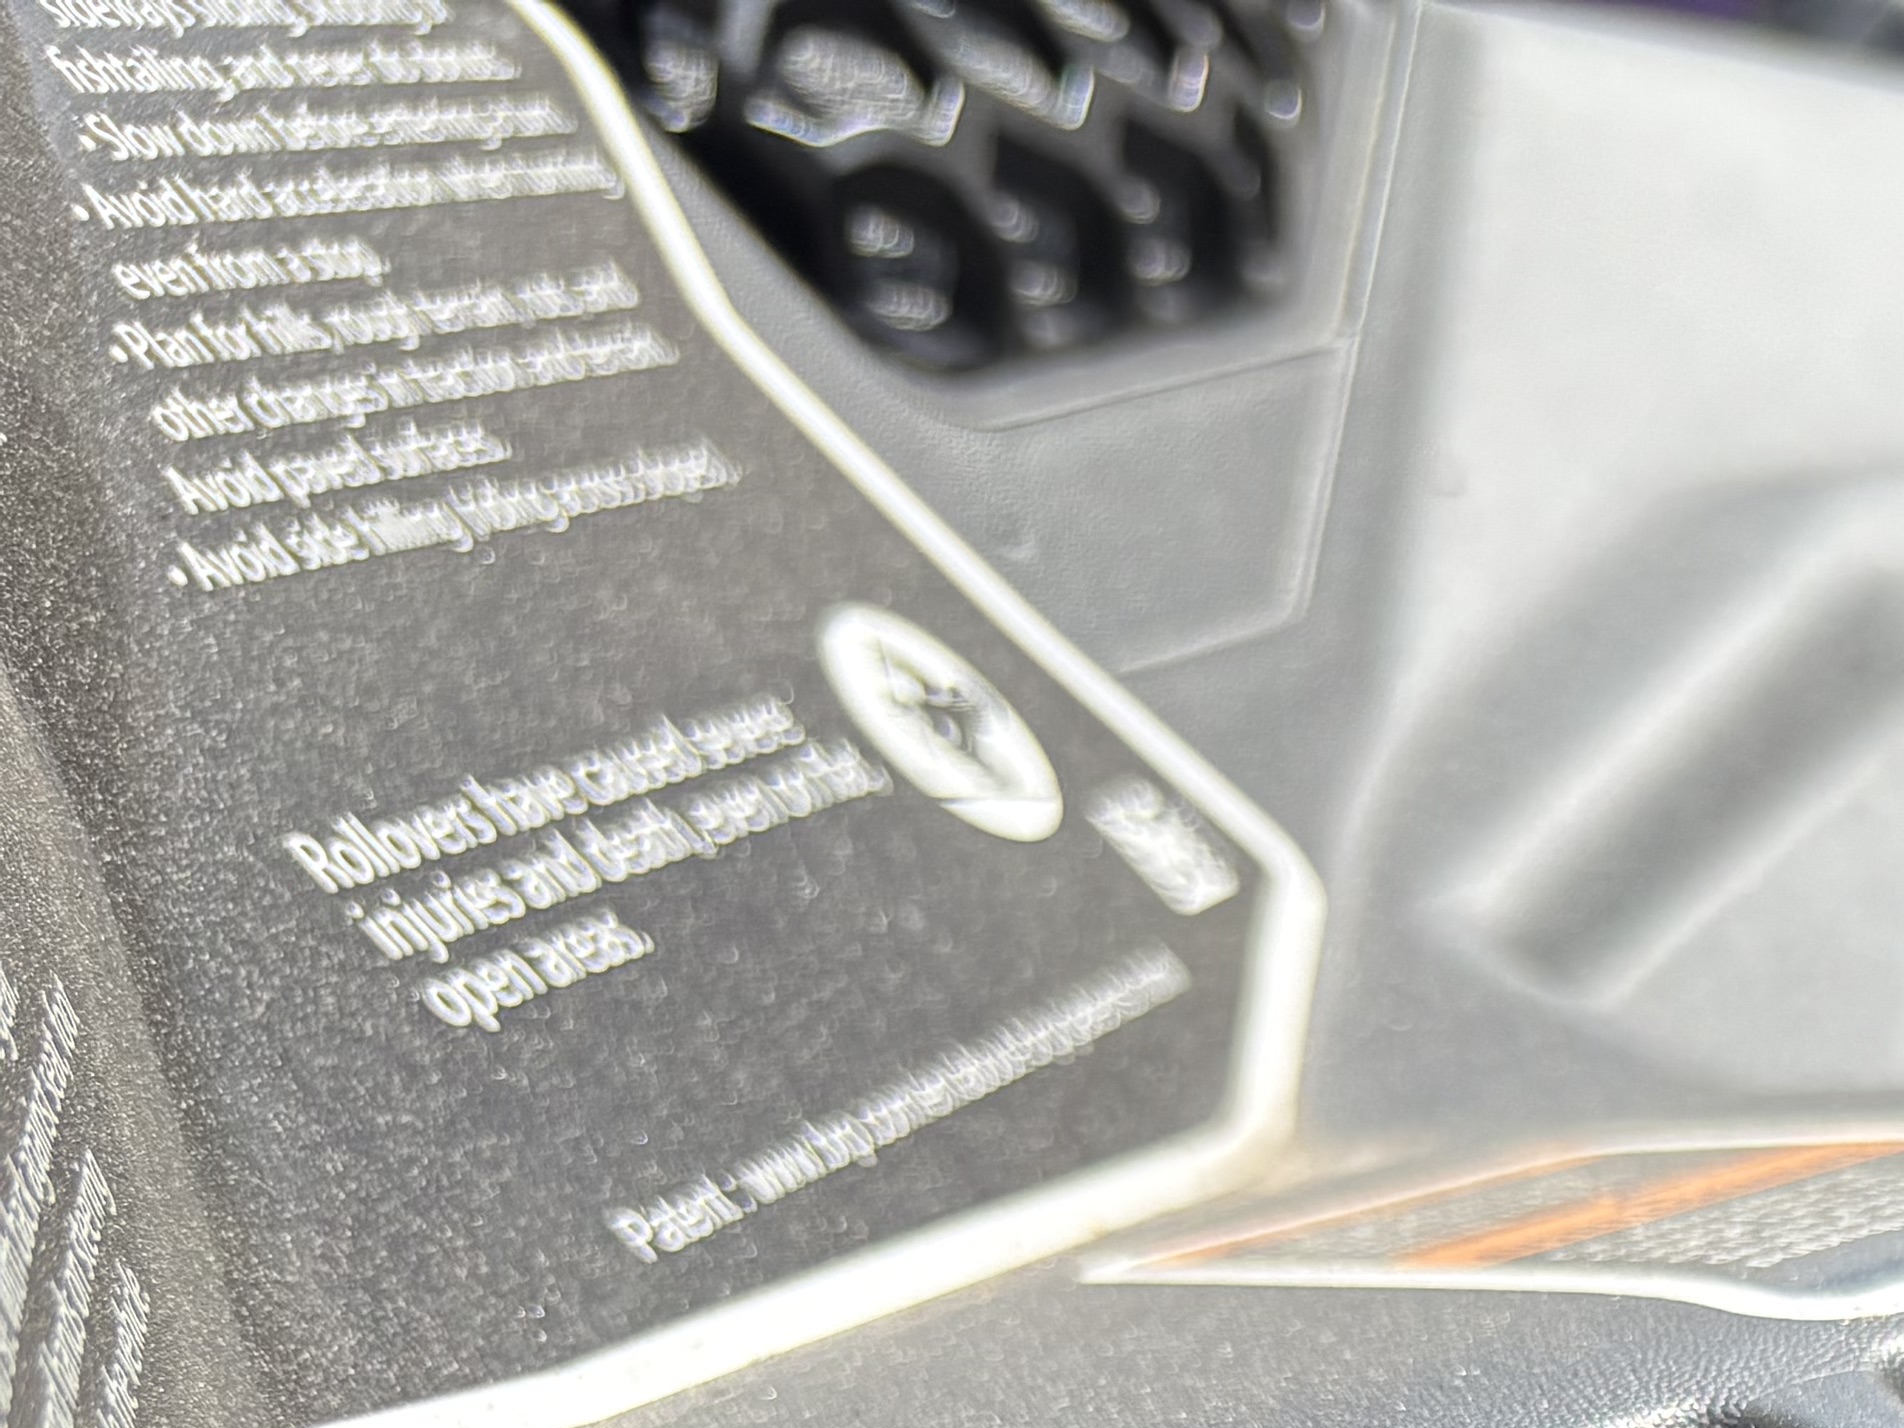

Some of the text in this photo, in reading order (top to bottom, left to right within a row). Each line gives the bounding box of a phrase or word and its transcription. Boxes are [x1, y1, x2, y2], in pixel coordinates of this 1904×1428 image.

[51, 47, 238, 101] fishtailing,
[224, 43, 297, 89] and
[87, 115, 187, 160] Slow
[173, 112, 282, 157] down
[264, 102, 376, 149] before
[82, 178, 198, 228] Avoid
[180, 168, 274, 222] hard
[112, 257, 210, 300] even
[186, 245, 291, 292] from
[274, 246, 315, 284] a
[113, 316, 213, 365] Plan
[190, 307, 263, 356] for
[239, 300, 345, 351] hills,
[149, 386, 261, 443] other
[244, 370, 390, 432] changes
[367, 357, 426, 408] in
[162, 448, 284, 515] Avoid
[268, 427, 384, 511] paved
[175, 518, 302, 590] Avoid
[286, 508, 371, 572] side
[284, 797, 501, 894] Rollovers
[464, 770, 594, 839] have
[569, 719, 712, 811] caused
[348, 869, 531, 962] injuries
[505, 832, 608, 912] and
[571, 800, 723, 888] death,
[690, 783, 797, 853] even
[416, 906, 657, 1036] open areas.
[39, 1021, 73, 1114] seat,
[20, 1067, 57, 1201] against
[4, 1150, 39, 1267] back
[70, 1154, 117, 1283] steering
[65, 1244, 91, 1321] on
[48, 1281, 84, 1412] hands
[114, 1266, 151, 1393] vehicle.
